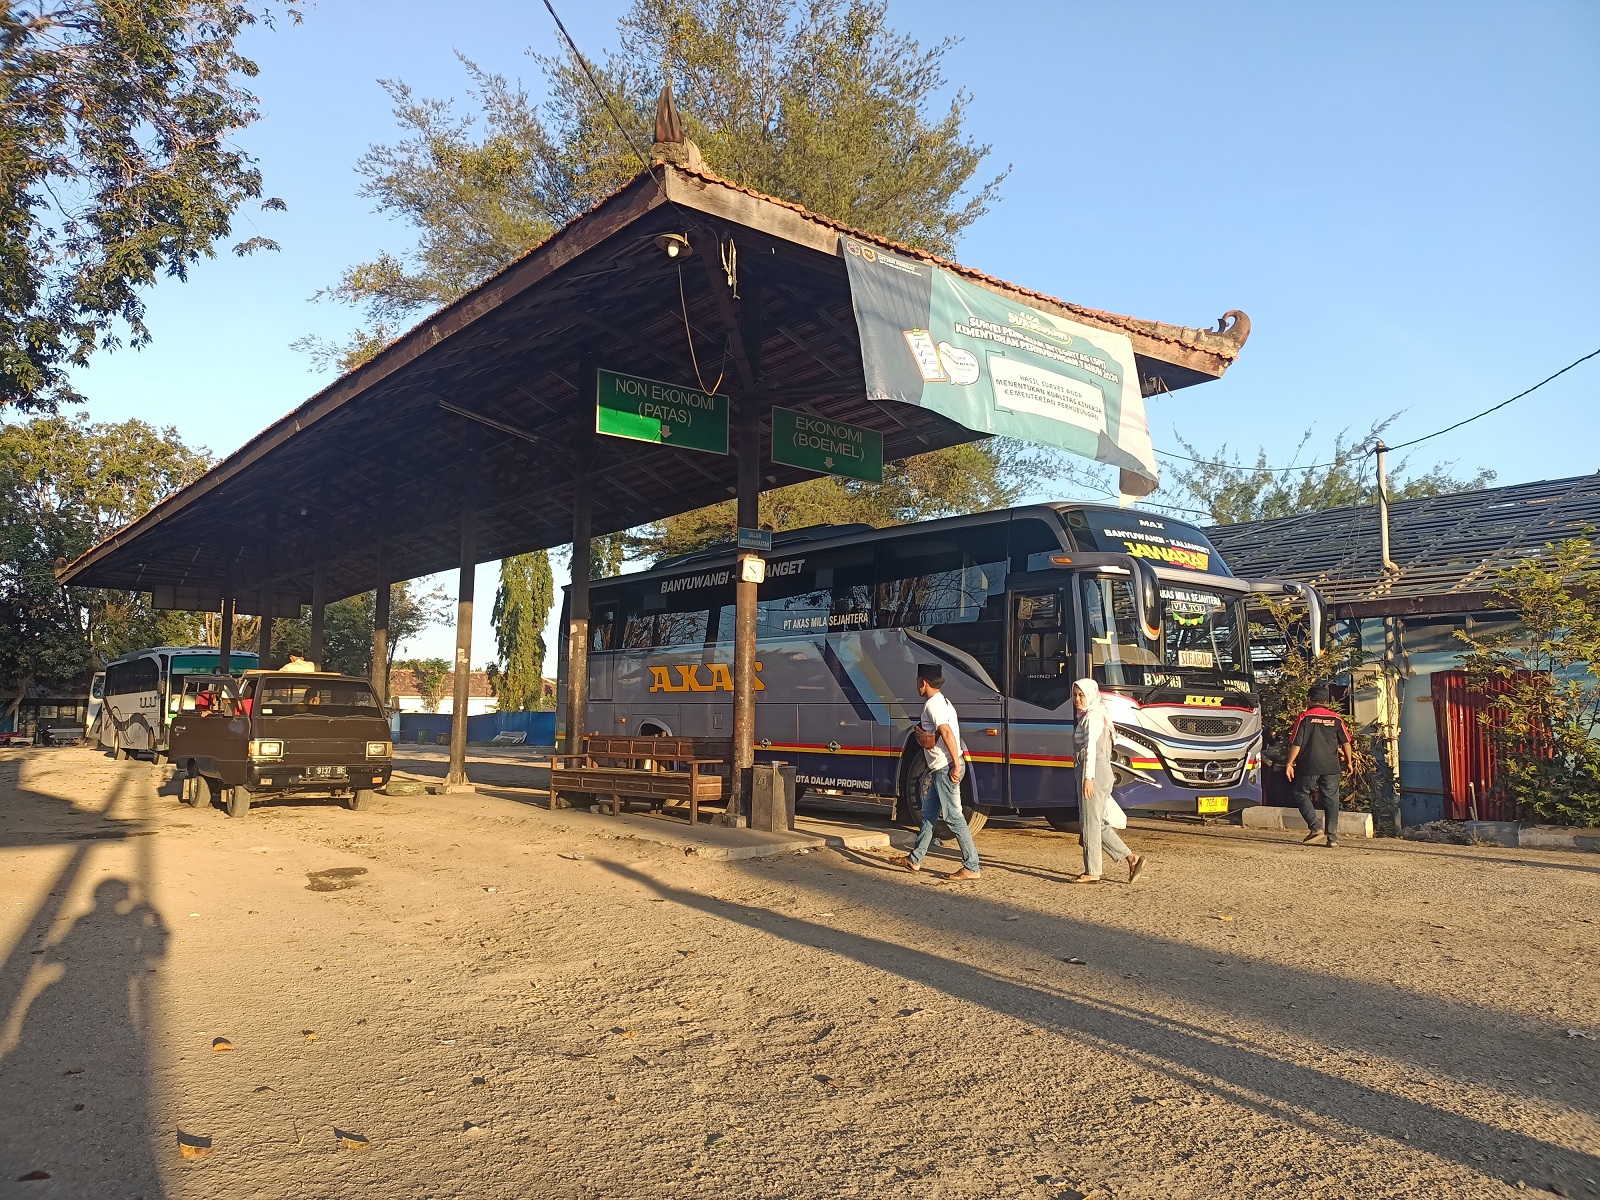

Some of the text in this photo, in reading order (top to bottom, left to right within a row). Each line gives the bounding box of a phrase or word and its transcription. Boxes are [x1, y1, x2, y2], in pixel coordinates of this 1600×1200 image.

[955, 323, 1019, 348] KEMENTERIAN
[1020, 340, 1080, 368] PERHUBUNGAN
[1079, 361, 1102, 377] TAHUN
[969, 317, 1002, 333] SURVEI
[1045, 343, 1090, 363] INTEGRITAS
[615, 378, 714, 411] NON EKONOMI
[995, 379, 1103, 414] MENENTUKAN KUALITAS KINERJA
[1020, 375, 1082, 399] HASIL SURVEI ANDA
[638, 401, 692, 427] (PATAS)
[1004, 388, 1099, 420] KEMENTERIAN PERHUBUNGAN
[795, 416, 863, 443] EKONOMI
[792, 432, 865, 462] (BOEMEL)
[1138, 519, 1165, 530] MAX
[1103, 529, 1166, 544] BANYUWANGI
[1169, 538, 1211, 555] KALIANGET
[1123, 541, 1208, 569] JAWARA
[660, 571, 730, 594] BANYUWANGI
[1159, 589, 1222, 606] AKAS MILA SEJAHTERA
[1173, 602, 1205, 613] VIA TOL
[783, 612, 869, 630] PT AKAS MILA SEJAHTERA
[307, 767, 312, 775] L
[796, 774, 872, 790] OTA DALAM PROPINSI
